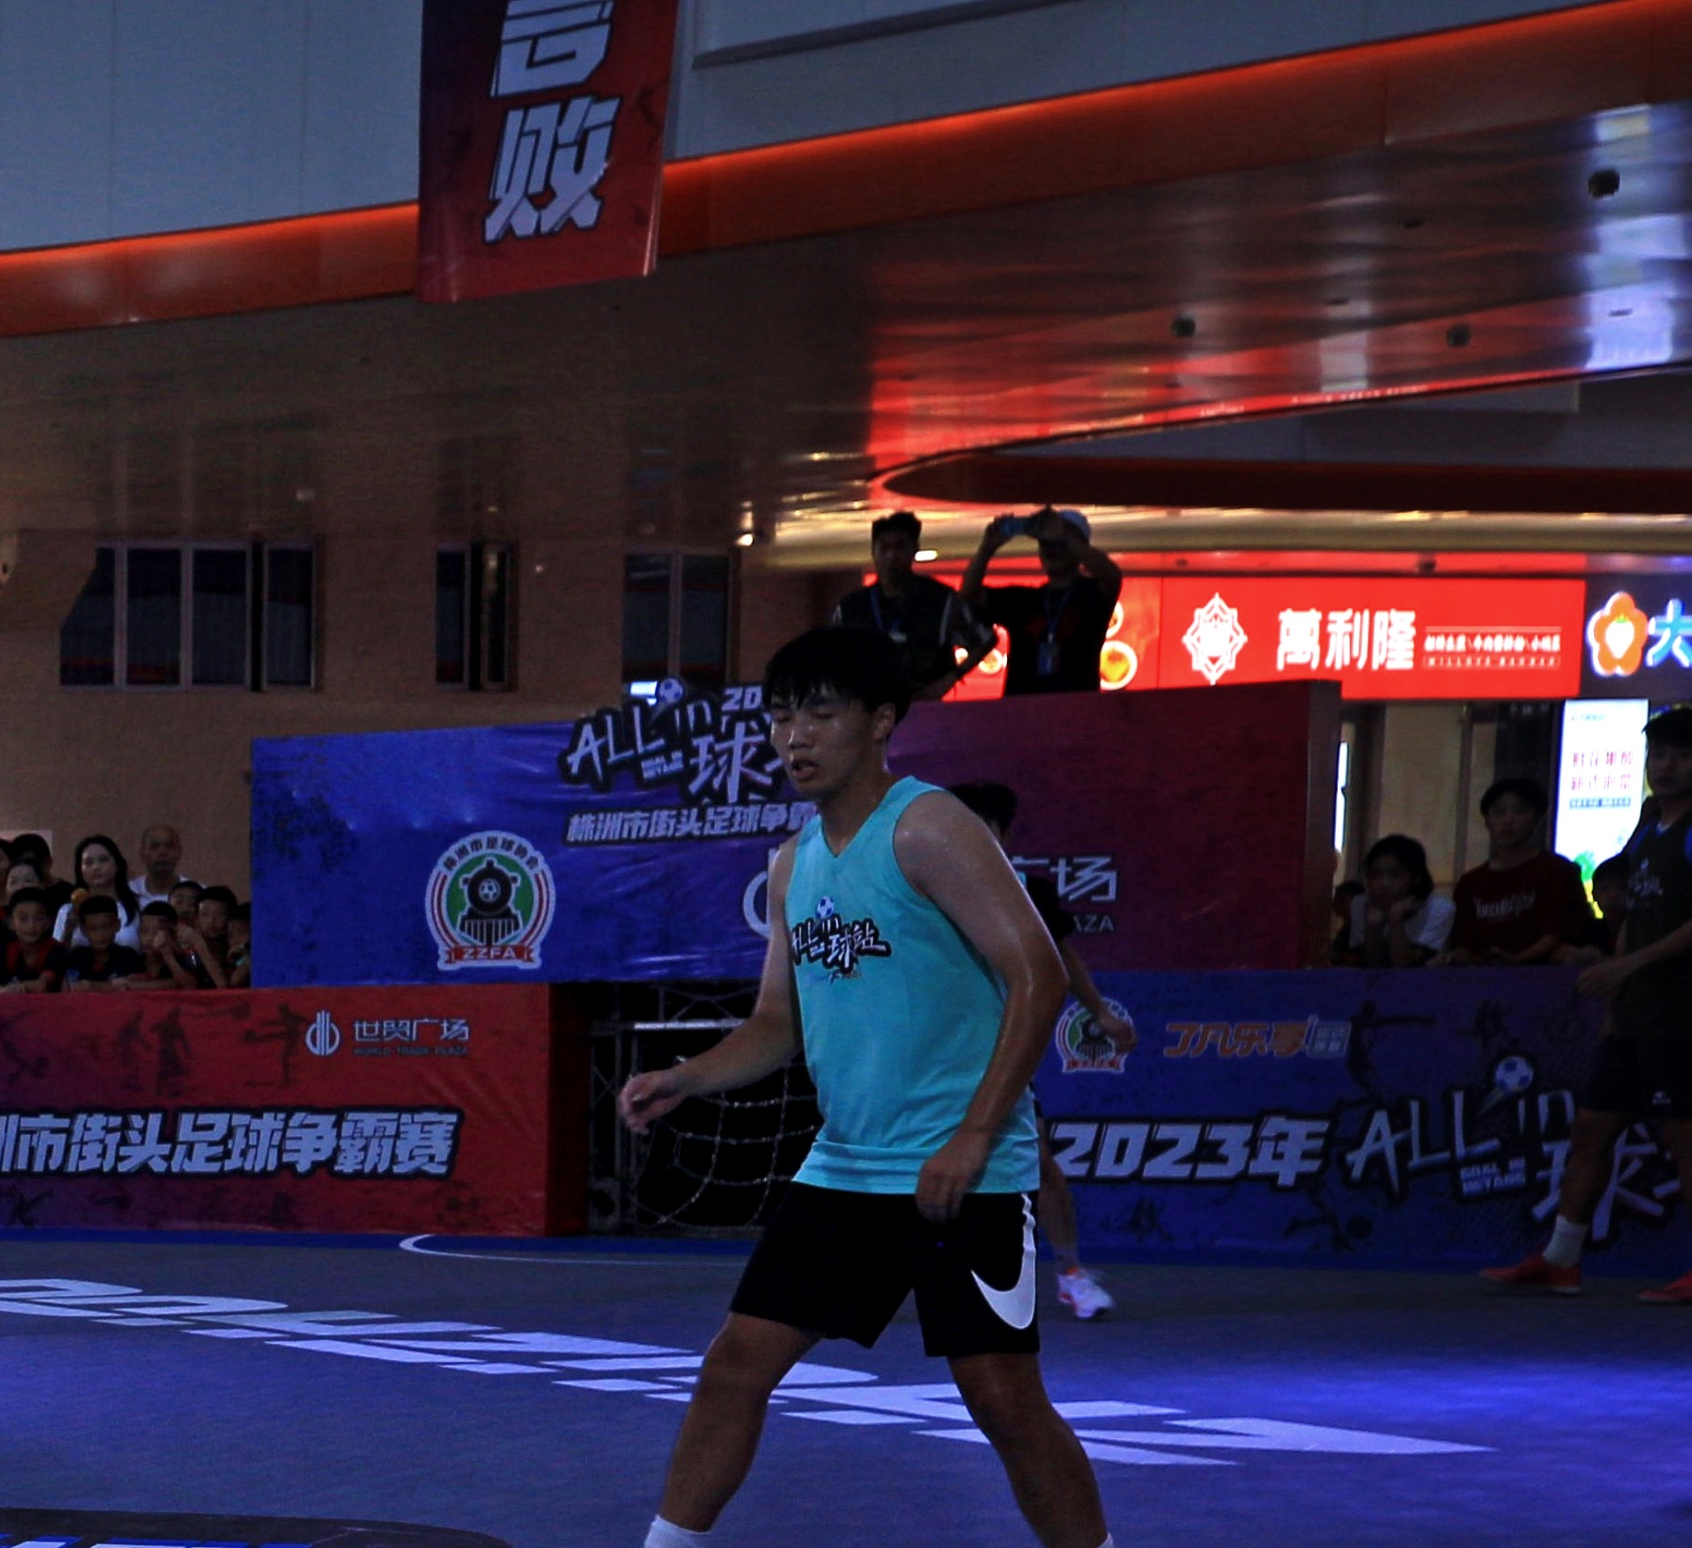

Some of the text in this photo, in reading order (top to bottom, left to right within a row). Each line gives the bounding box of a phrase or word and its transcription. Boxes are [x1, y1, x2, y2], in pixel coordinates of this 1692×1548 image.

[1277, 608, 1416, 671] 萬利隆
[567, 705, 665, 781] ALL
[689, 712, 783, 804] 球
[826, 920, 888, 969] 球站
[353, 1017, 470, 1043] 世贸广场
[1050, 1116, 1331, 1187] 2023年
[1345, 1090, 1501, 1195] ALL
